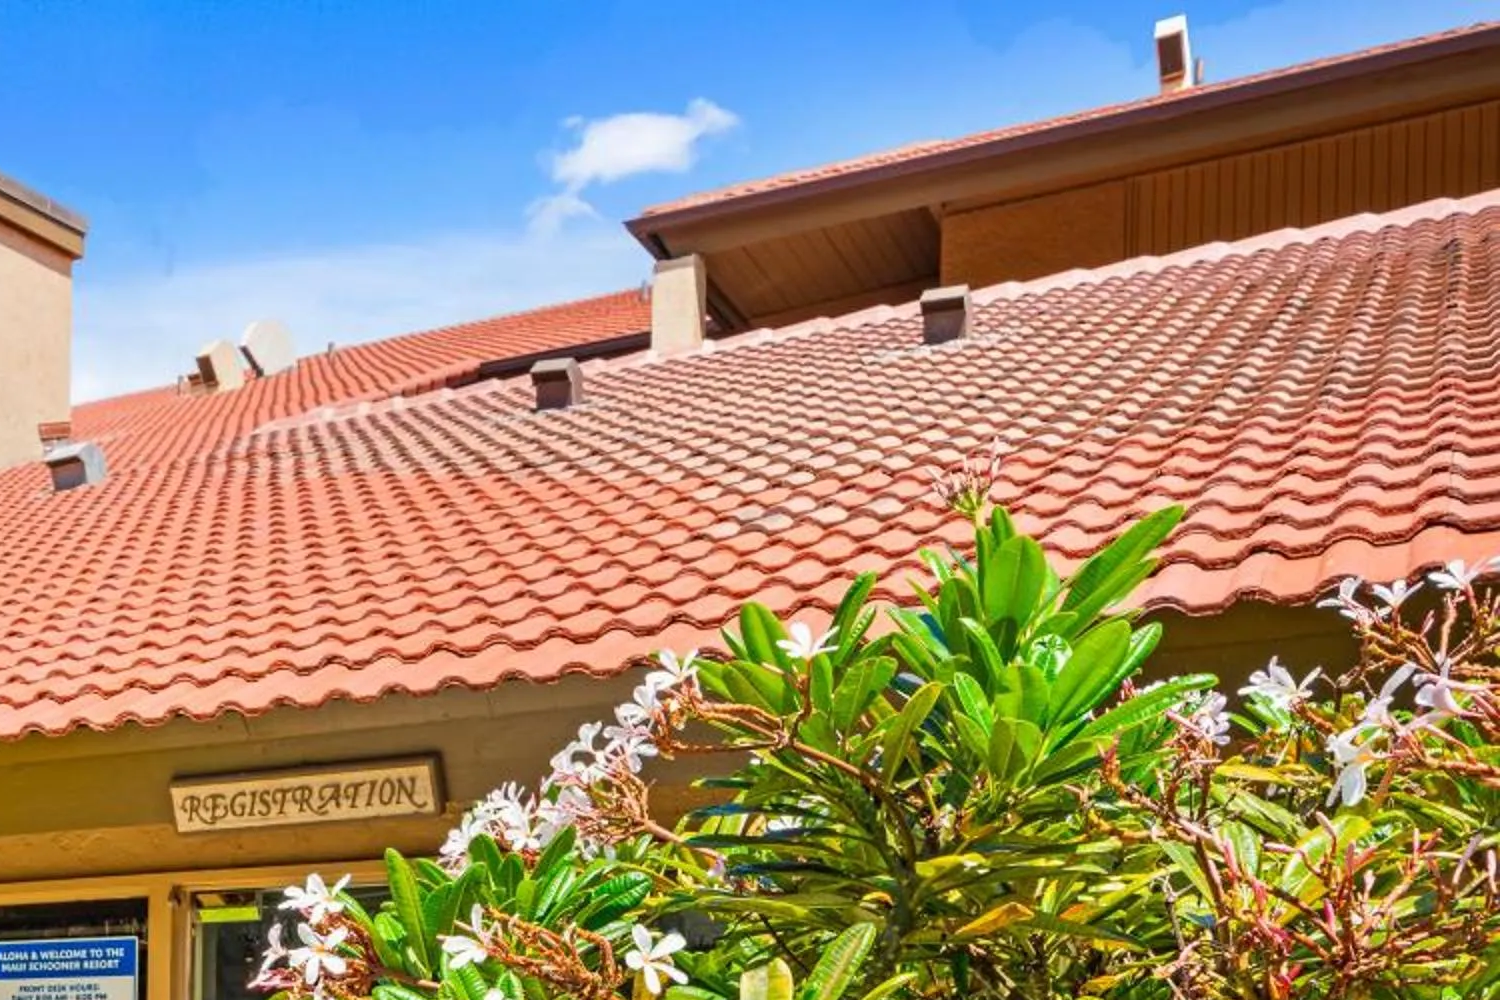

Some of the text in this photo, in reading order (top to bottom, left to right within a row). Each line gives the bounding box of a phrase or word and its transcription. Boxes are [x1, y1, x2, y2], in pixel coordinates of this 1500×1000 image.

[180, 775, 429, 825] REGISTRATION
[39, 949, 87, 960] WELCOME
[90, 948, 103, 958] TO
[106, 947, 125, 957] THE
[1, 959, 119, 973] MAUI SCHOONER RESORT
